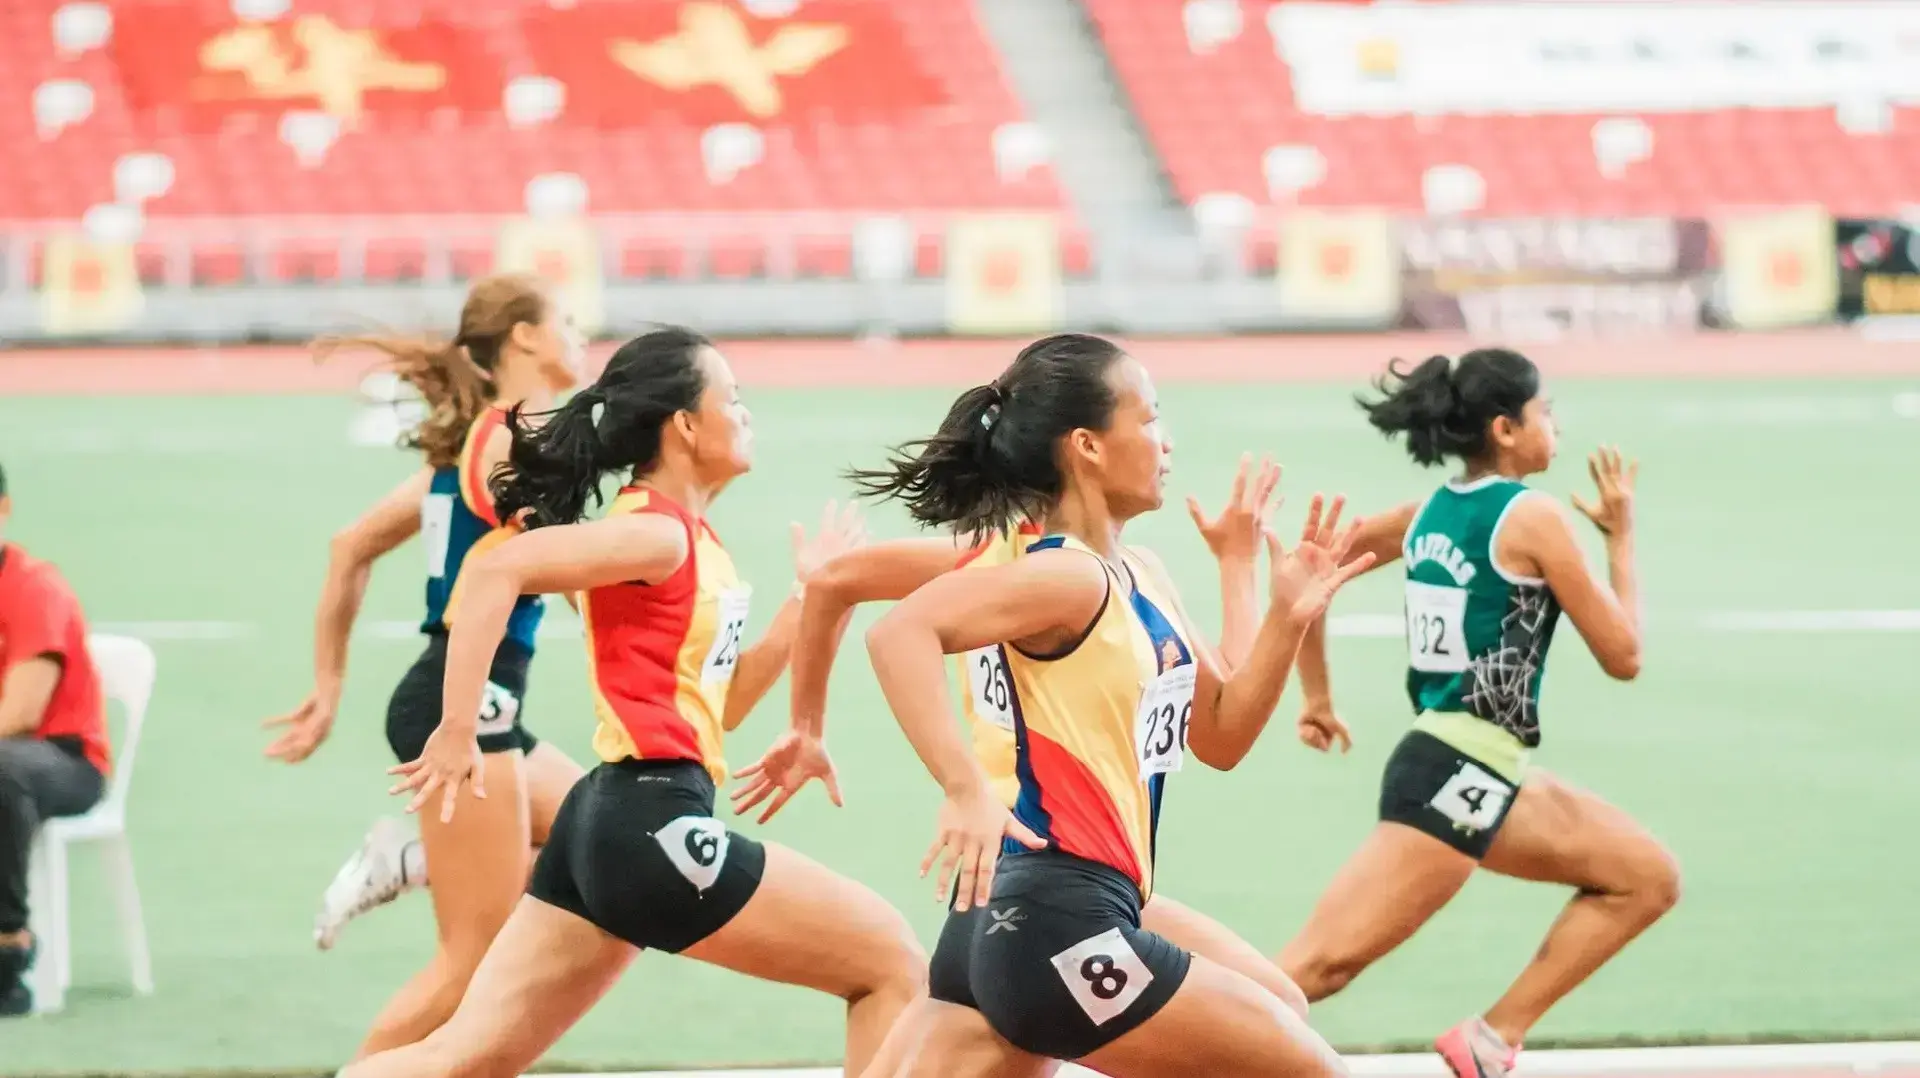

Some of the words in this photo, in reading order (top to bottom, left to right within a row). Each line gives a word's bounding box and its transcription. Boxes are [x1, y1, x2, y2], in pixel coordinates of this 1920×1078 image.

[1457, 785, 1489, 815] 4
[684, 826, 720, 868] 6
[1080, 953, 1129, 1000] 8
